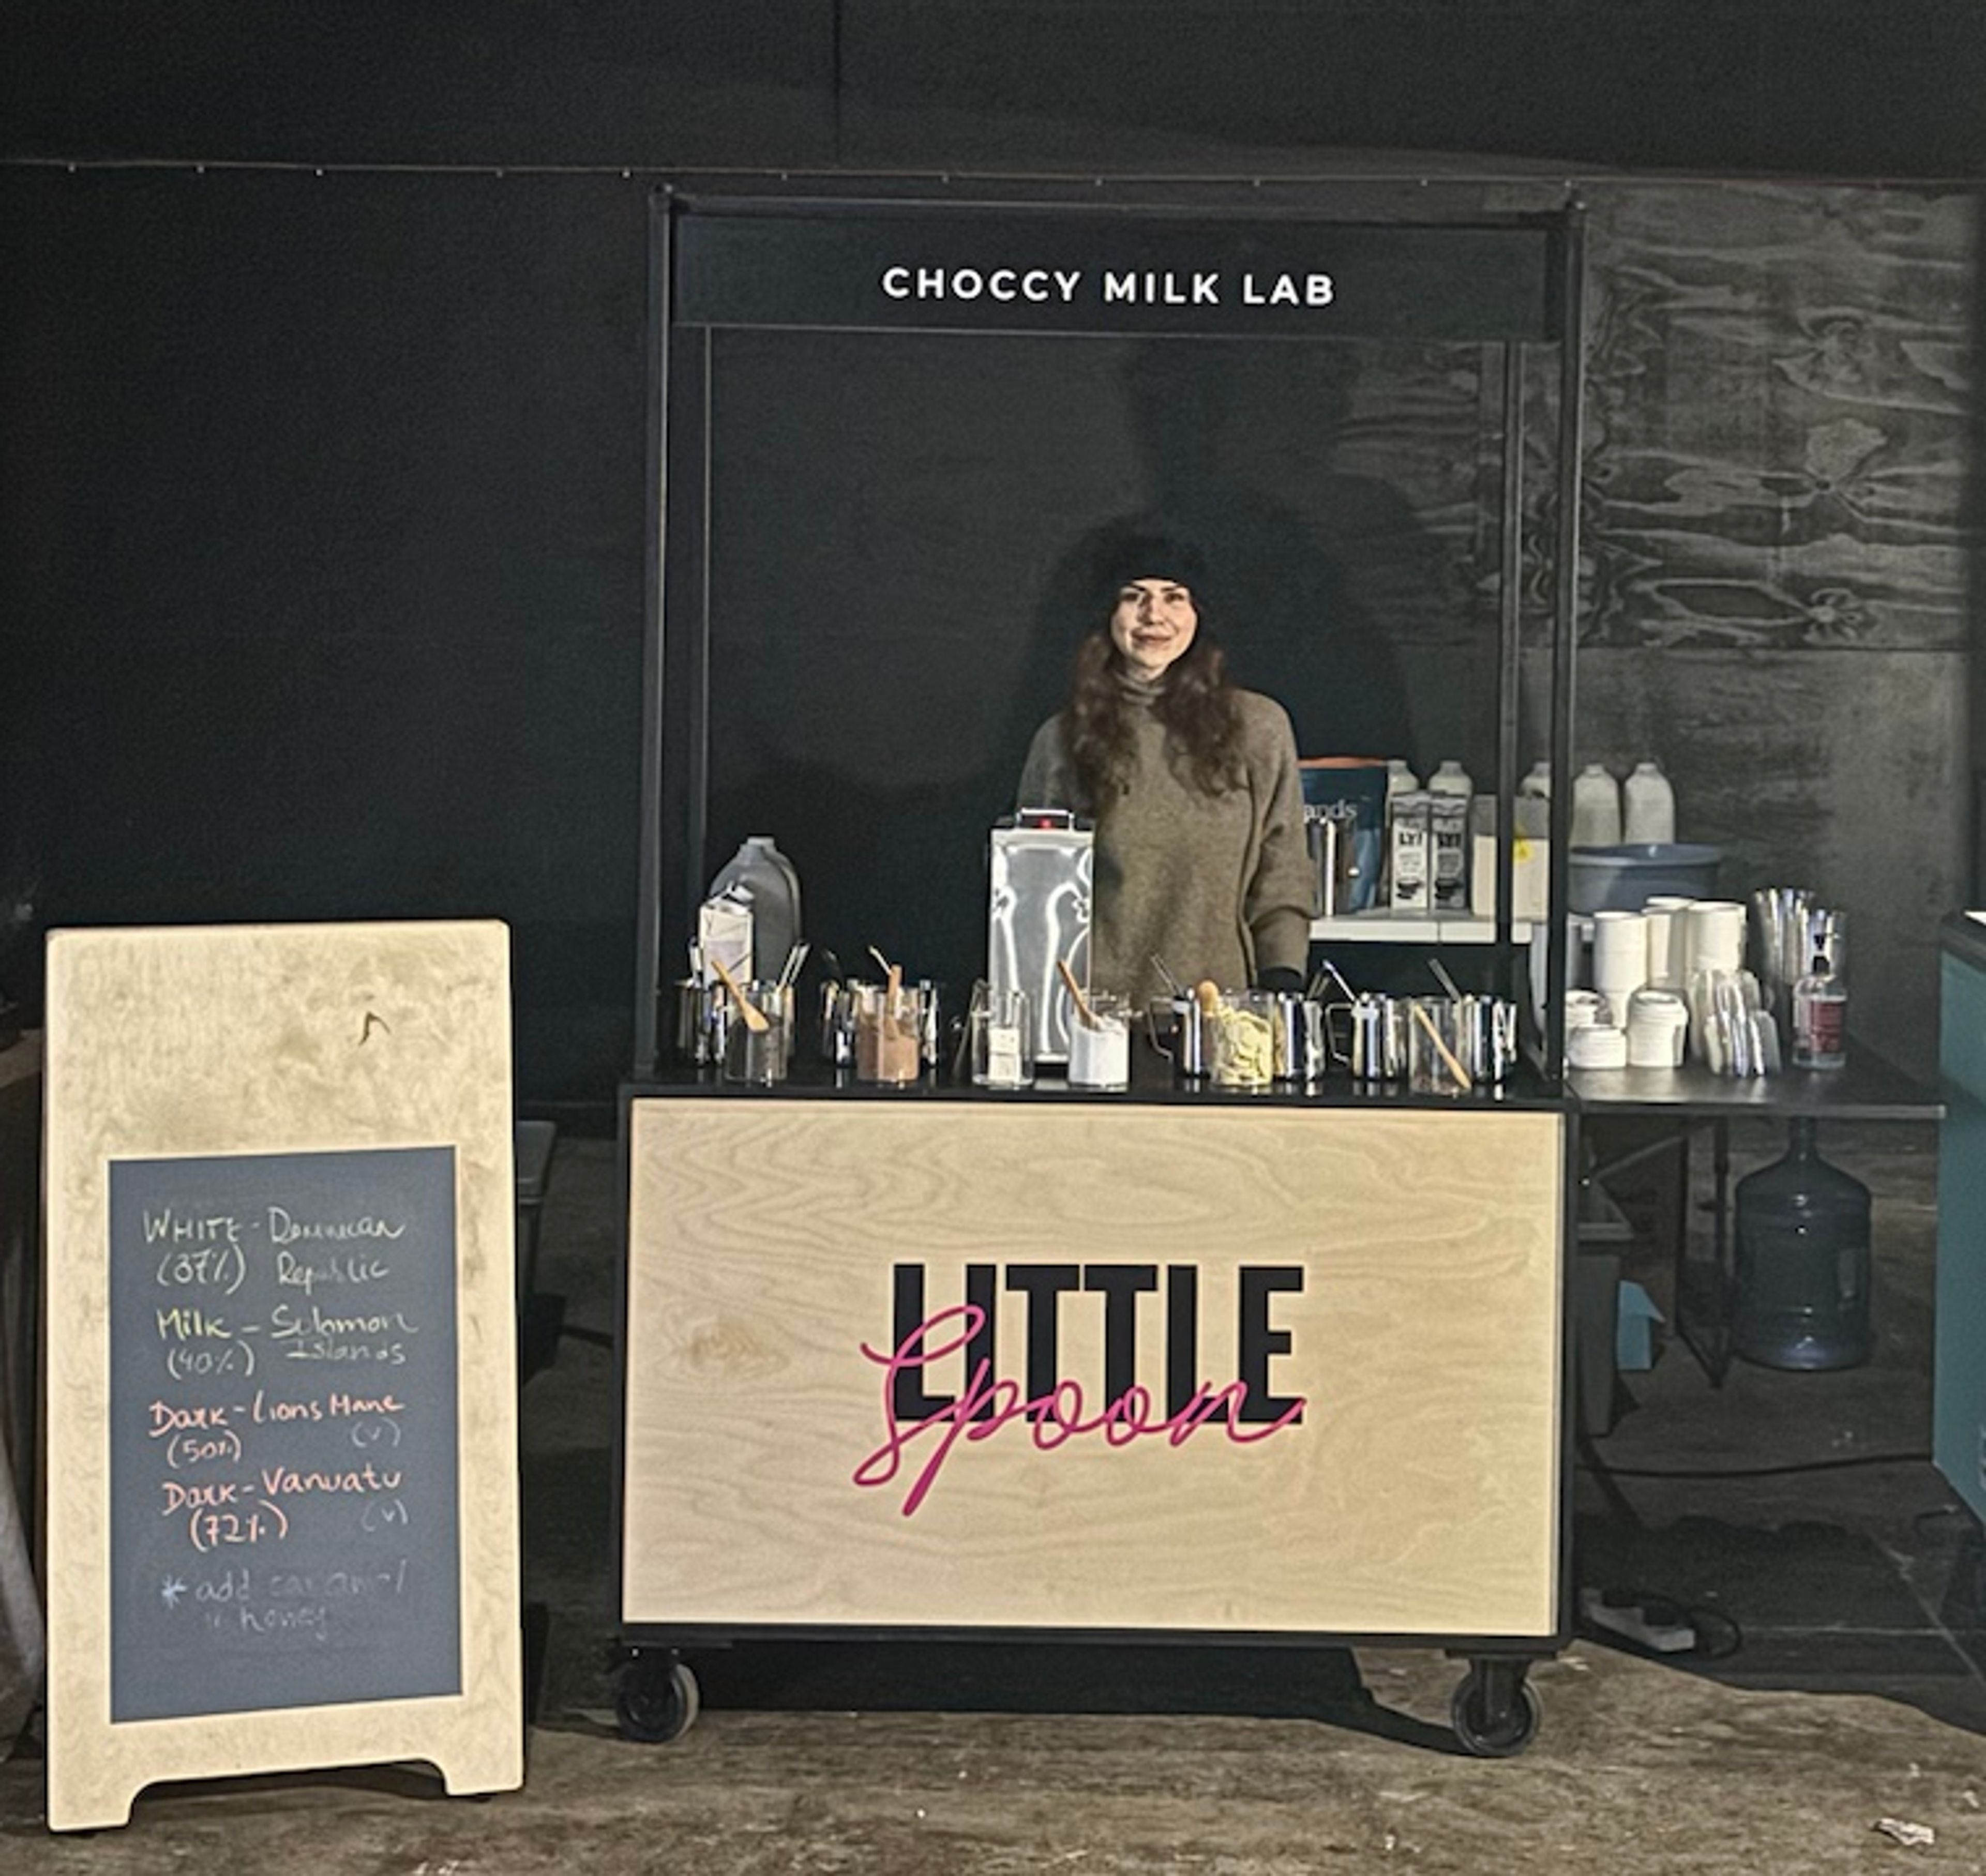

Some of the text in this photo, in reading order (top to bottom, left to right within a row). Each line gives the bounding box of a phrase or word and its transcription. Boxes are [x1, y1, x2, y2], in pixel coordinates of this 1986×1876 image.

[882, 267, 1335, 306] CHOCCY MILK LAB
[277, 1250, 389, 1295] Republic
[167, 1340, 255, 1380] (40%)
[894, 1263, 1304, 1424] LITTLE
[853, 1304, 1307, 1517] Spoon
[262, 1462, 401, 1496] Vanuatu
[190, 1500, 288, 1553] (72%)
